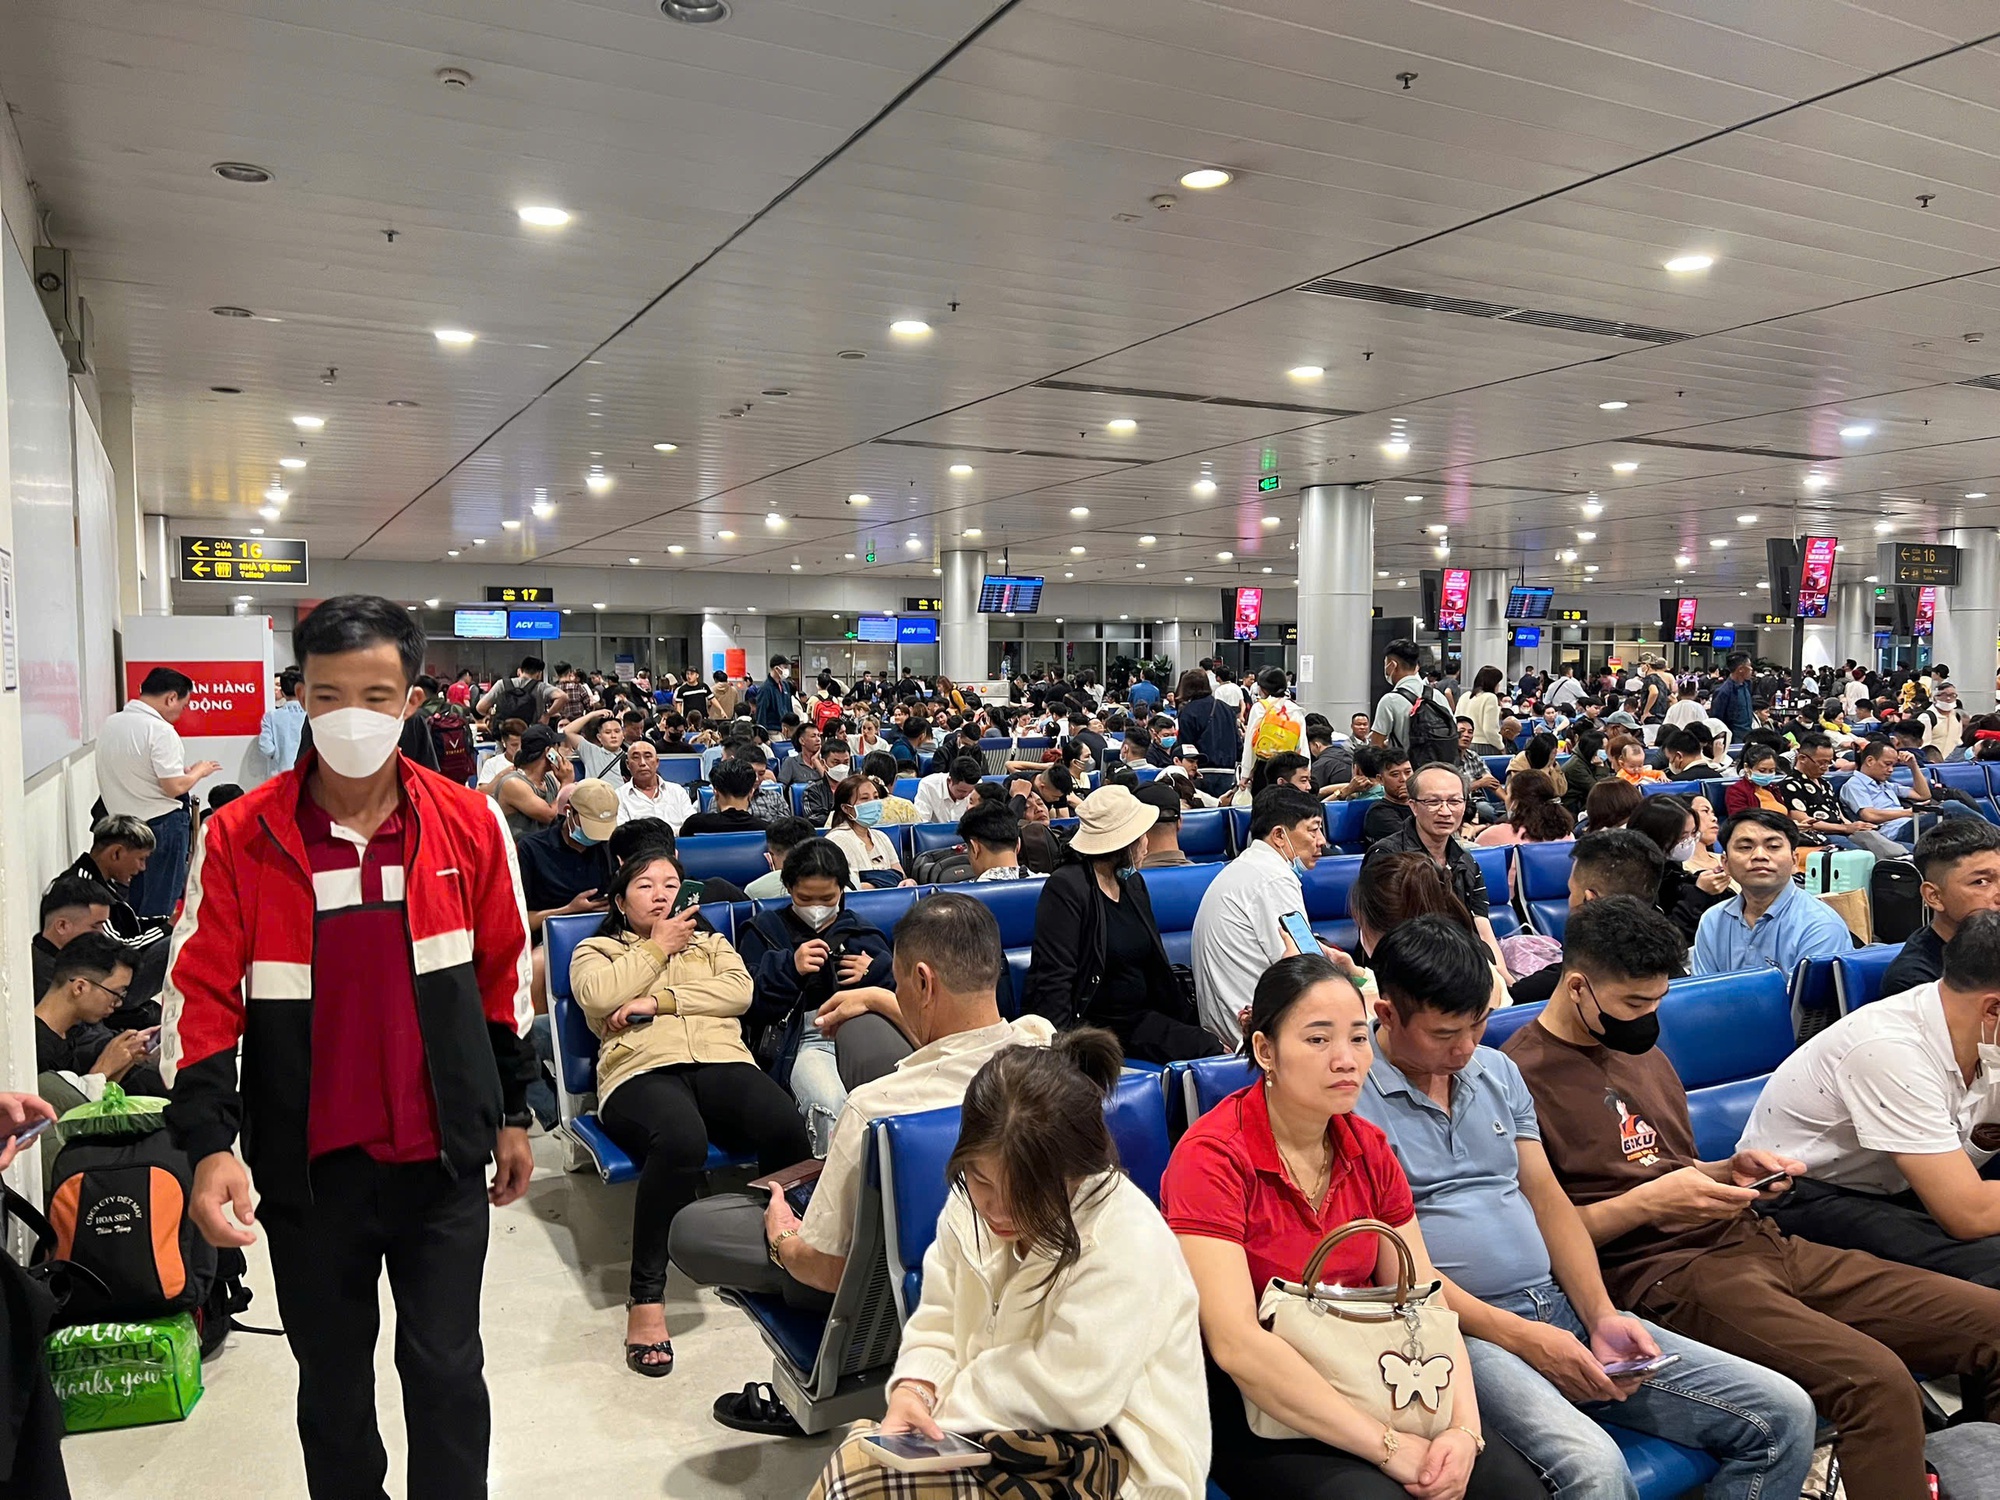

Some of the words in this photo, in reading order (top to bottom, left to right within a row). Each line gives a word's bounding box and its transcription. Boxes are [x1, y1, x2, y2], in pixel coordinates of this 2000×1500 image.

[239, 542, 263, 558] 16
[1924, 549, 1936, 562] 16
[521, 588, 538, 601] 17
[515, 621, 534, 629] ACV
[213, 680, 256, 694] HÀNG
[189, 697, 233, 713] ĐỘNG
[95, 1215, 113, 1224] HOA
[114, 1213, 131, 1222] SEN
[121, 1371, 161, 1397] you
